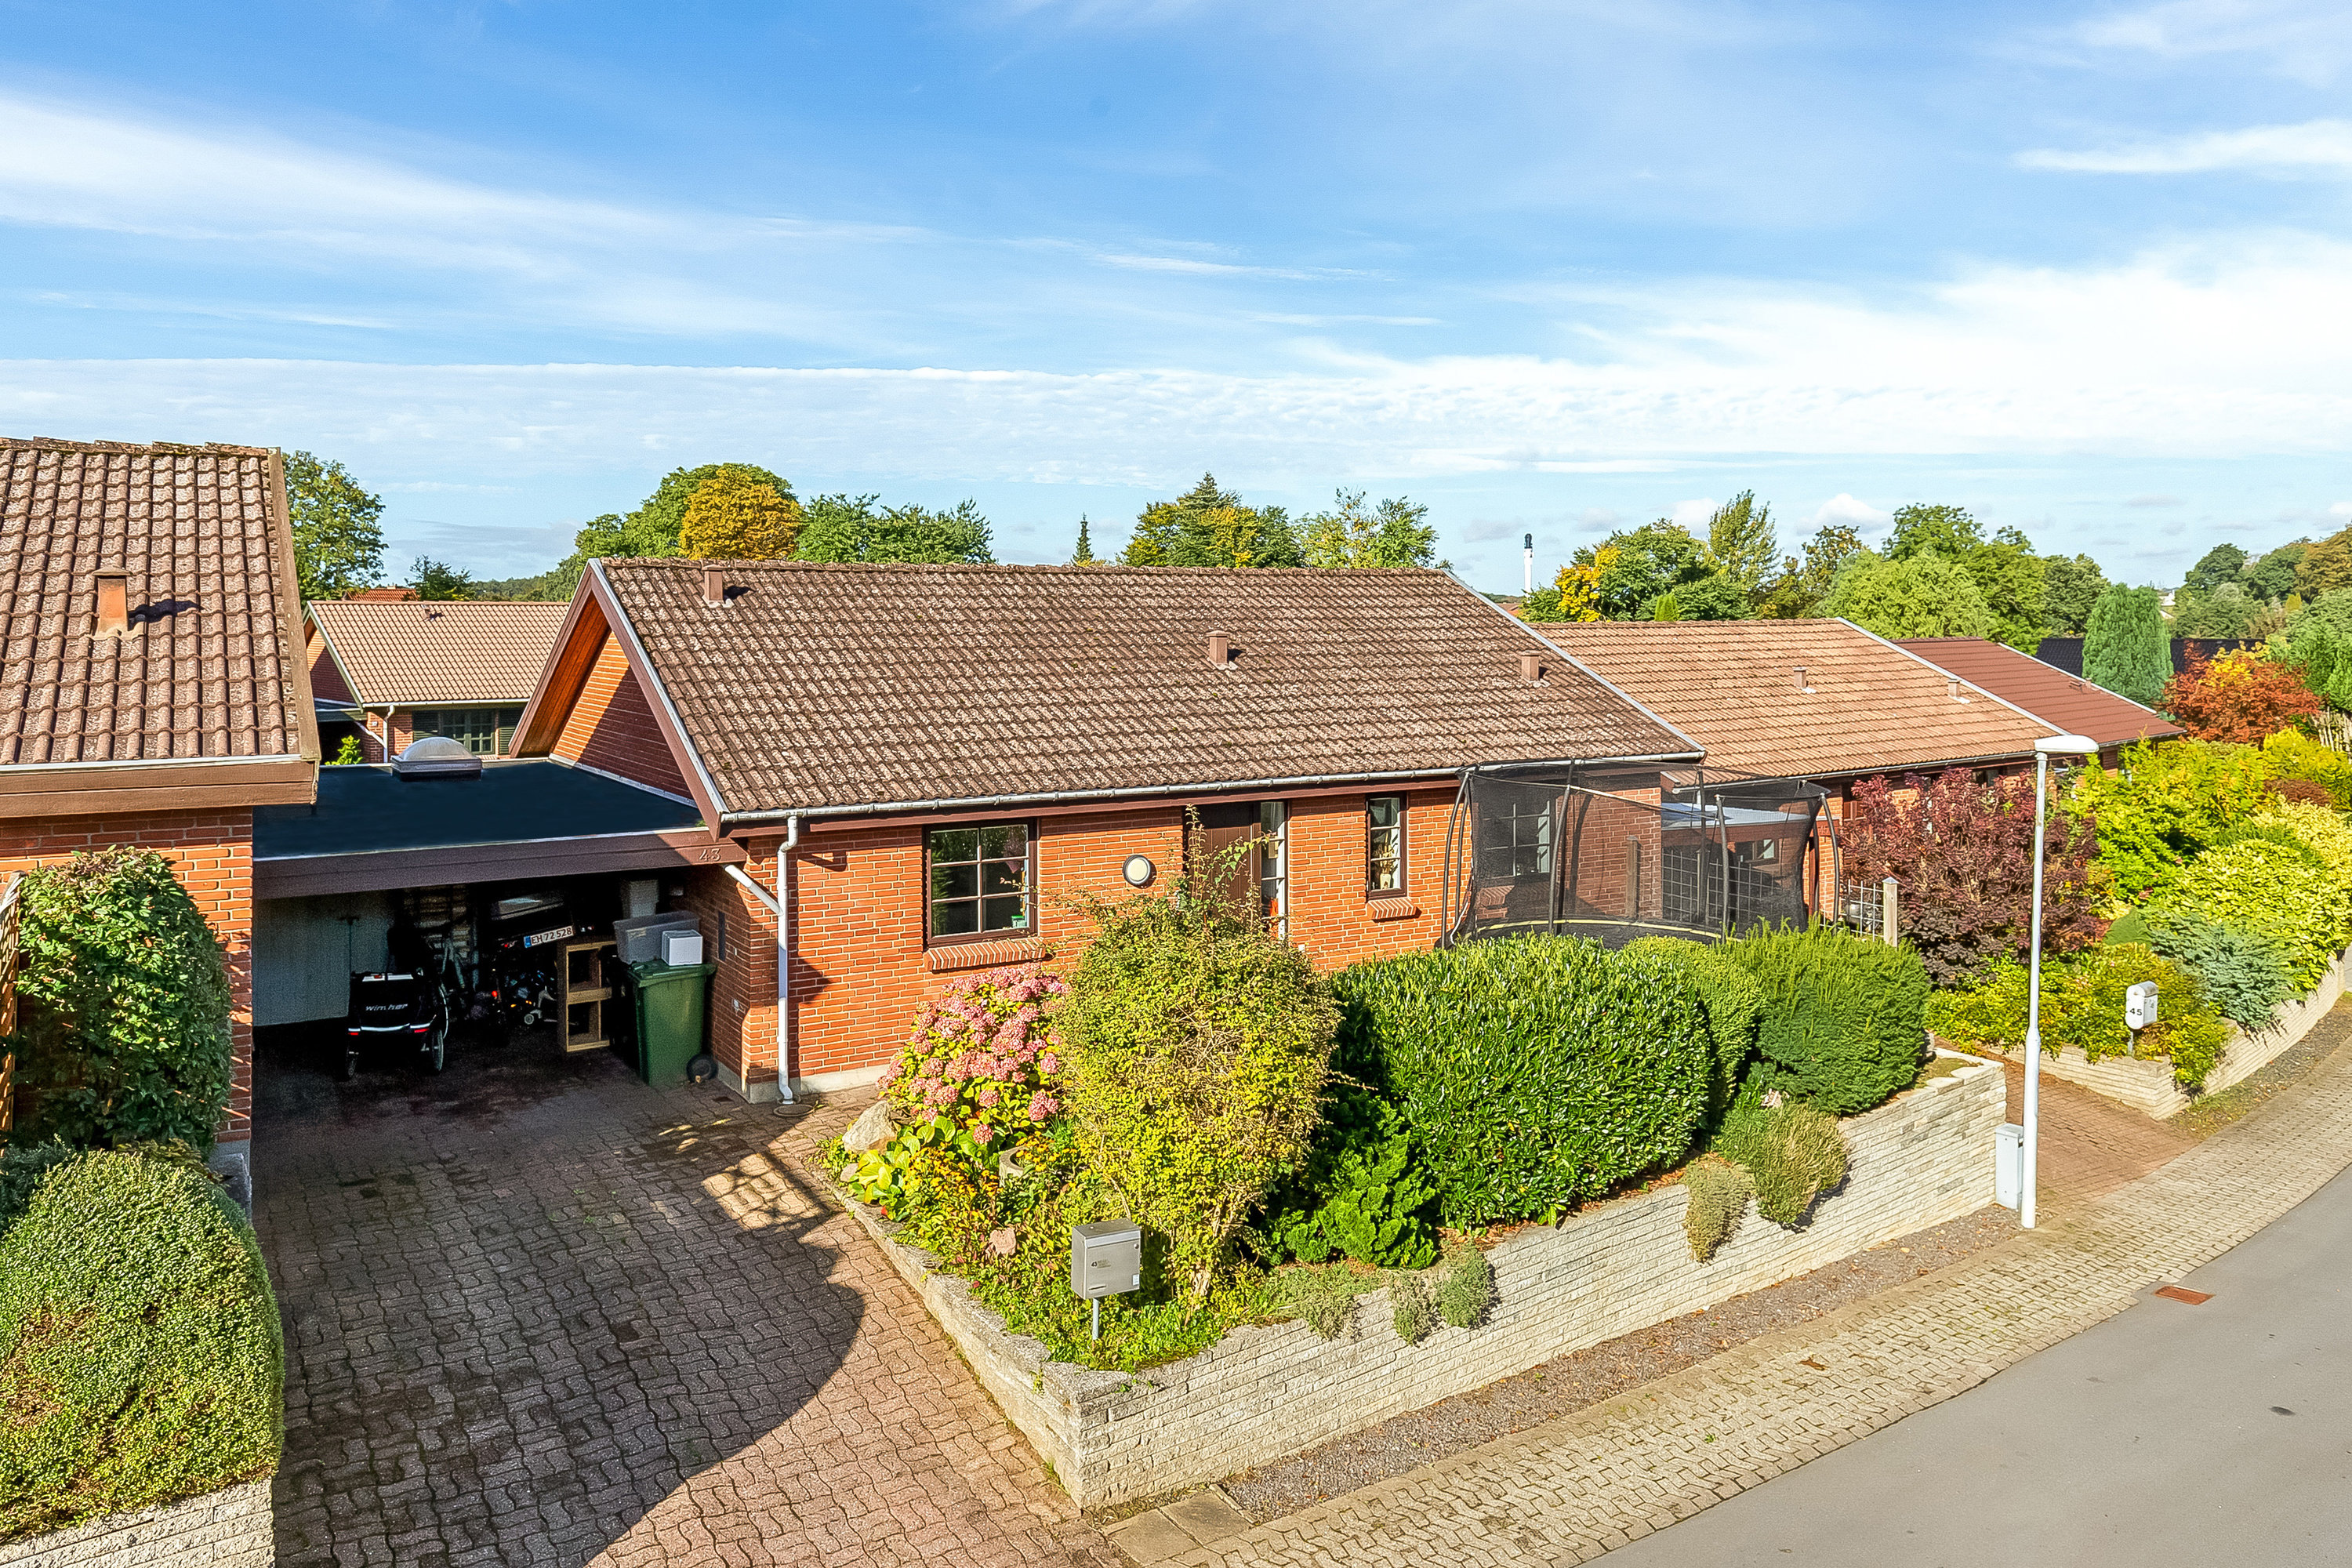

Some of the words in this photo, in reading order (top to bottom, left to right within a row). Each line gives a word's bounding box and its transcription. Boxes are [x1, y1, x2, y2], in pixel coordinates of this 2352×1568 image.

[699, 848, 720, 862] 43
[532, 935, 543, 944] EH
[544, 931, 555, 941] 72
[556, 927, 572, 938] 528
[2129, 1007, 2143, 1016] 45
